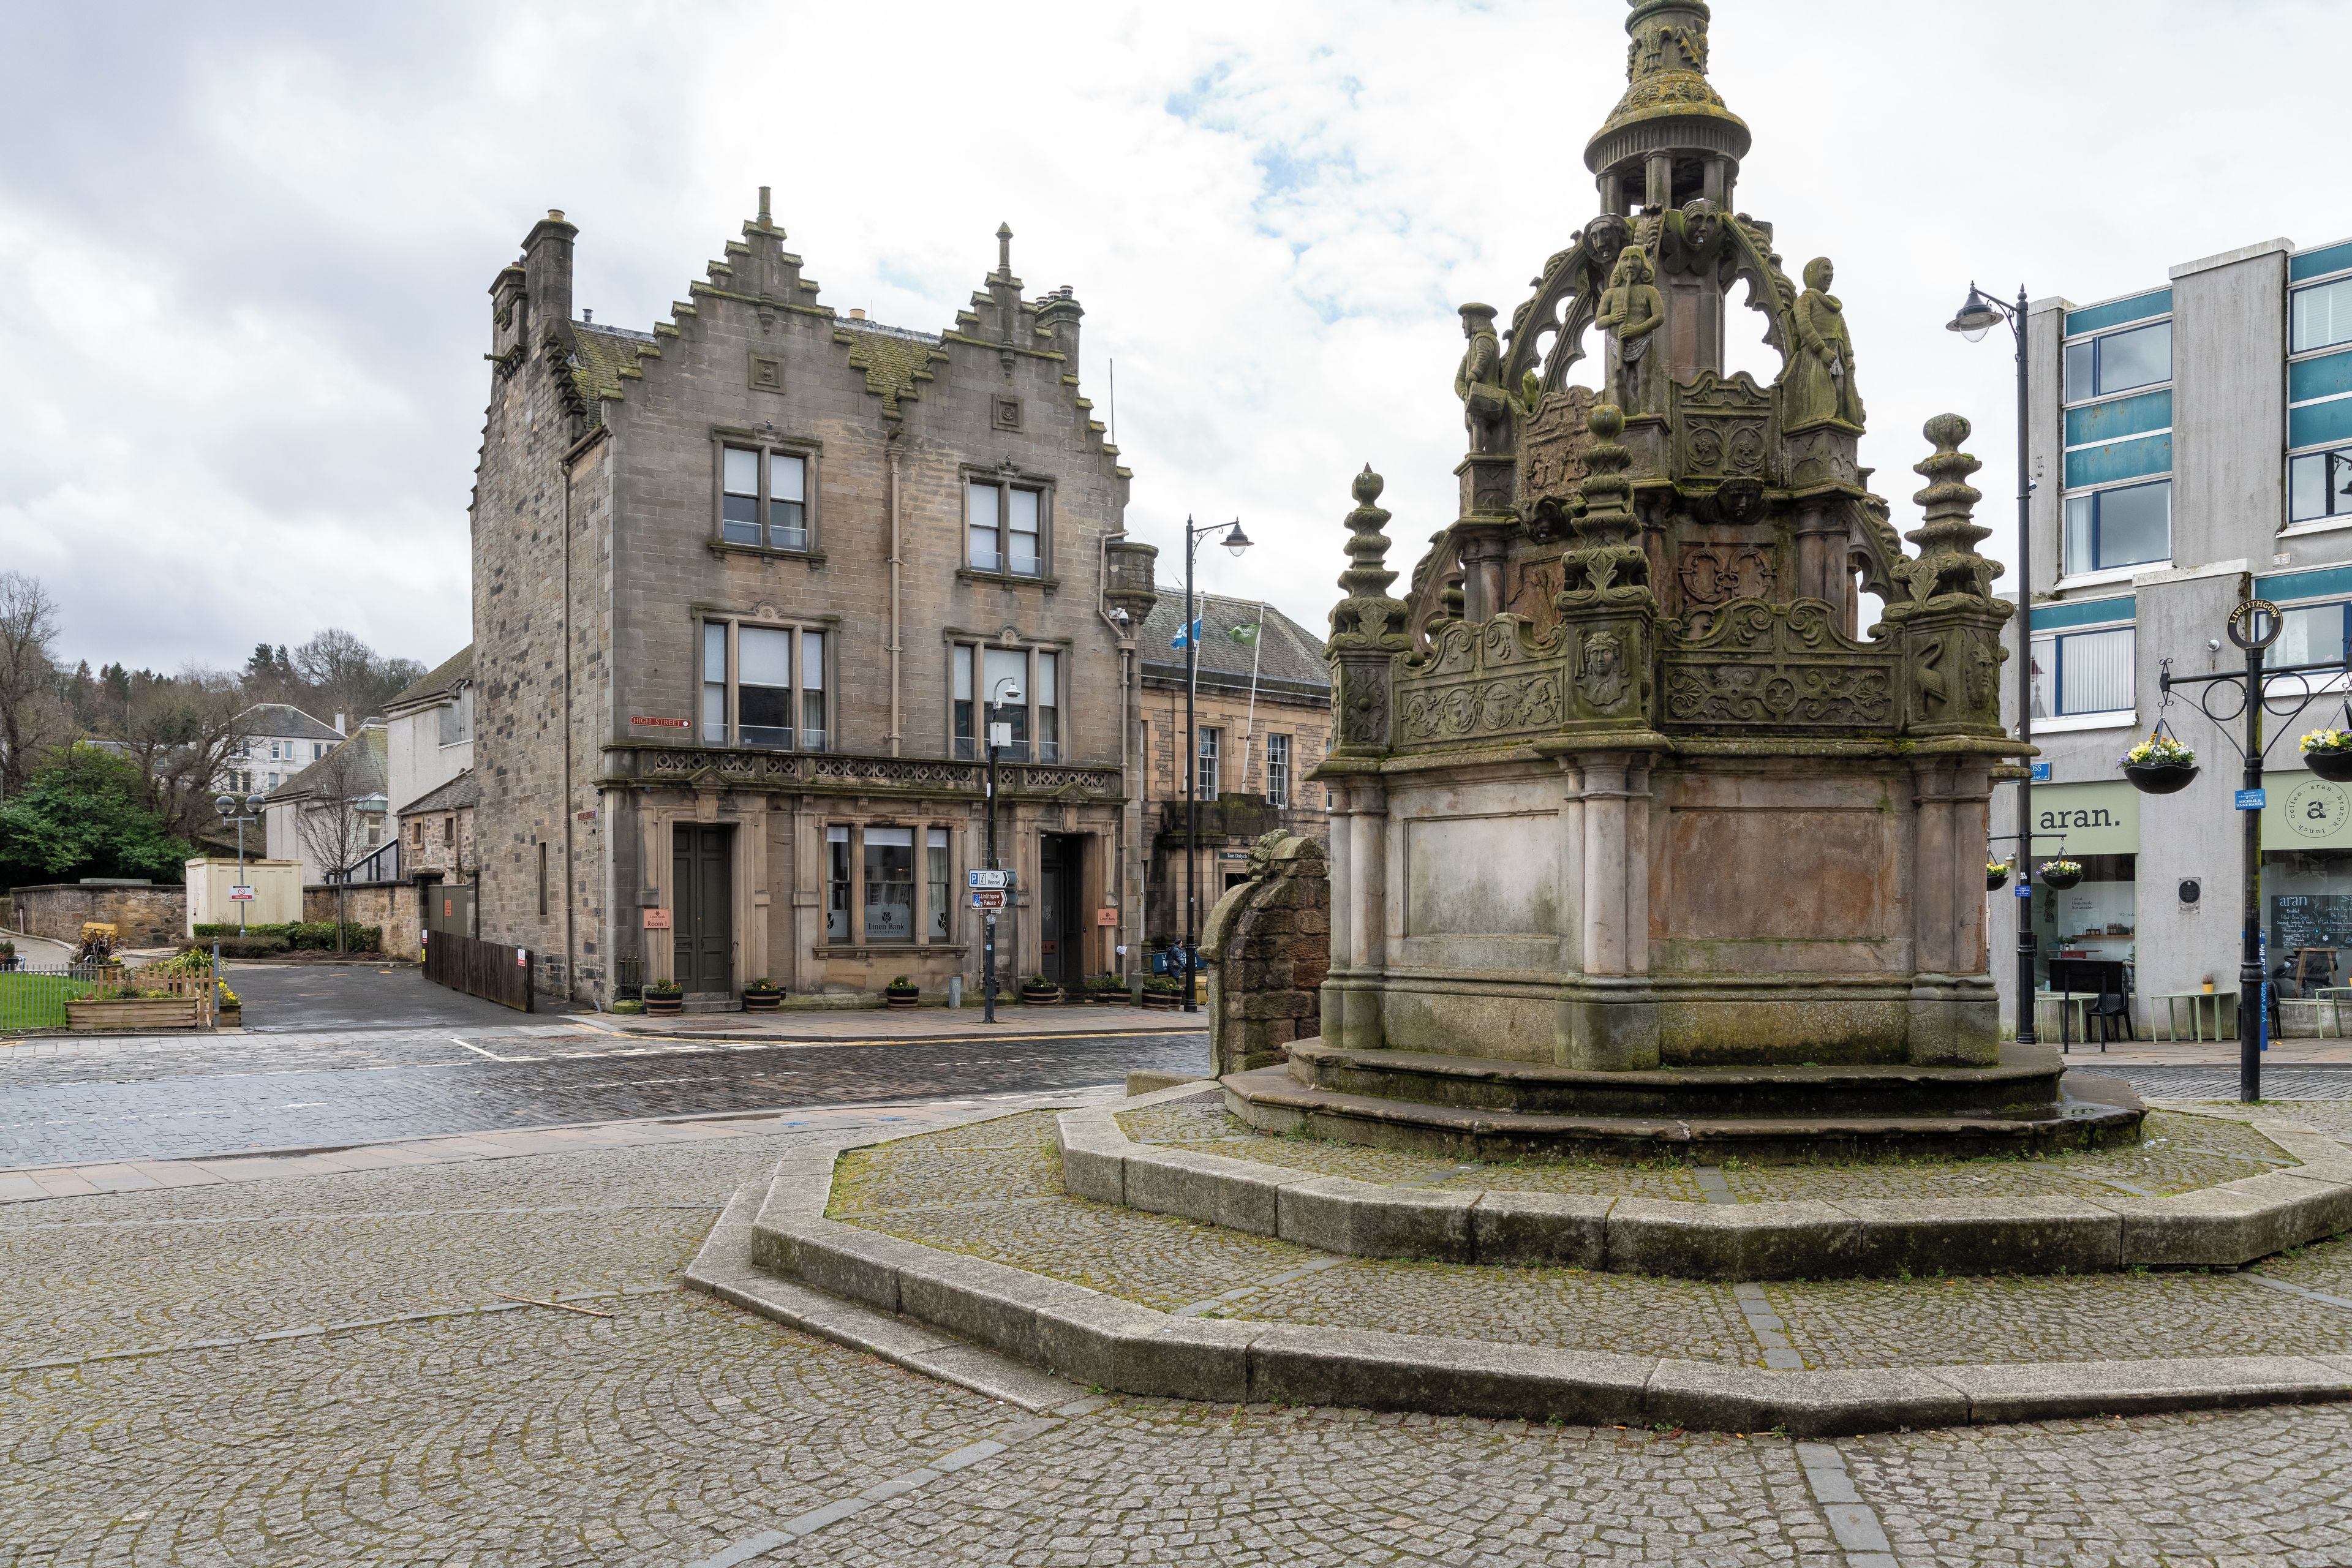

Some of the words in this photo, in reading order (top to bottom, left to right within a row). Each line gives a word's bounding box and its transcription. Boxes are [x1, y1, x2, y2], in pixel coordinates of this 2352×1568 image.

[2230, 601, 2279, 624] LINLITHGOW
[2040, 809, 2120, 829] aran.
[2280, 896, 2307, 907] aran
